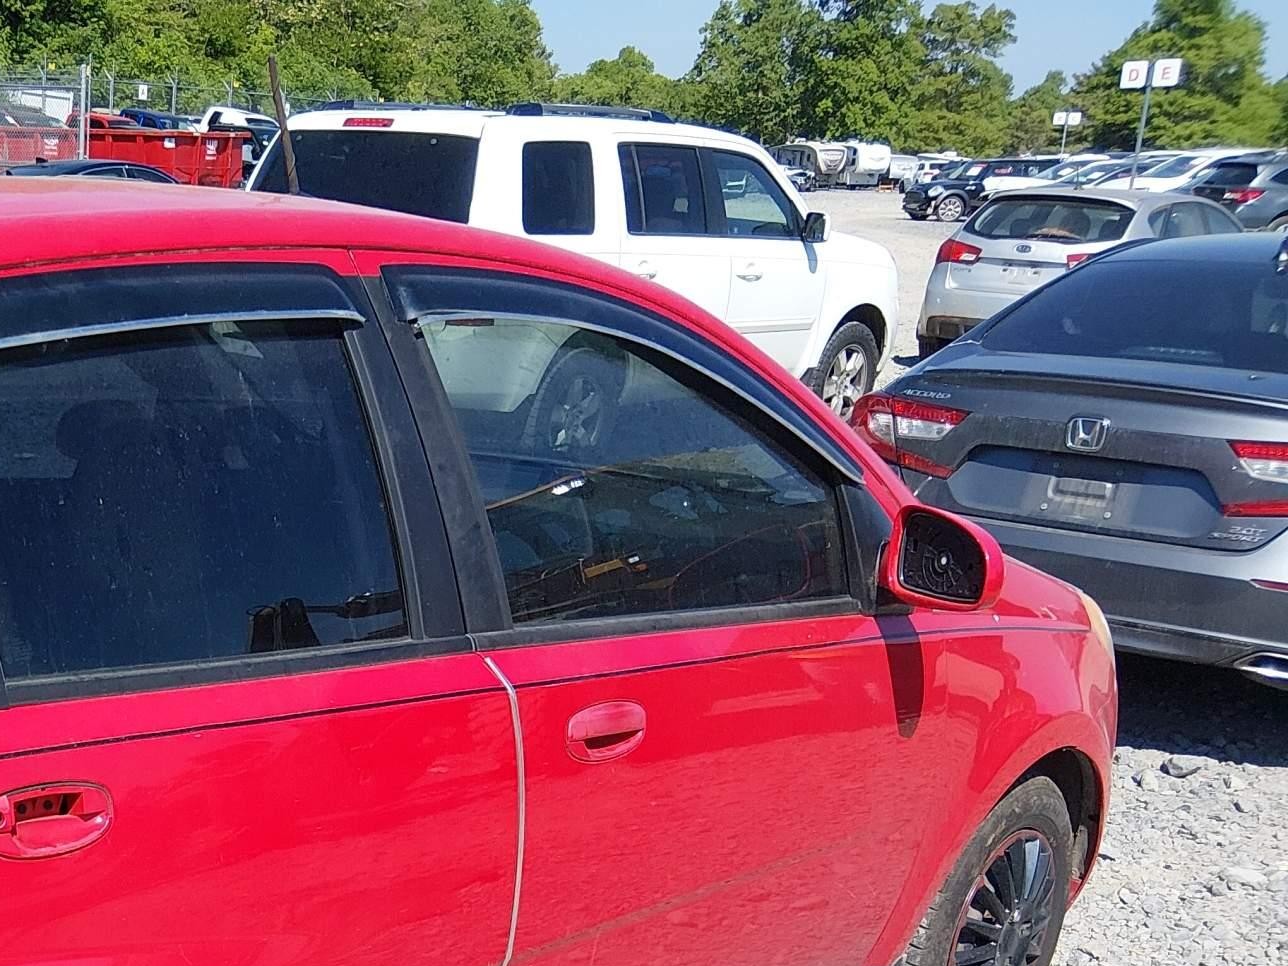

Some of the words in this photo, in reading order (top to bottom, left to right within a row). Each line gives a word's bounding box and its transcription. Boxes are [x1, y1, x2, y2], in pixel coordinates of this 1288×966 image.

[1128, 68, 1140, 82] D
[1161, 66, 1172, 80] E
[899, 388, 952, 399] ACCORD
[1207, 532, 1265, 543] SPORT
